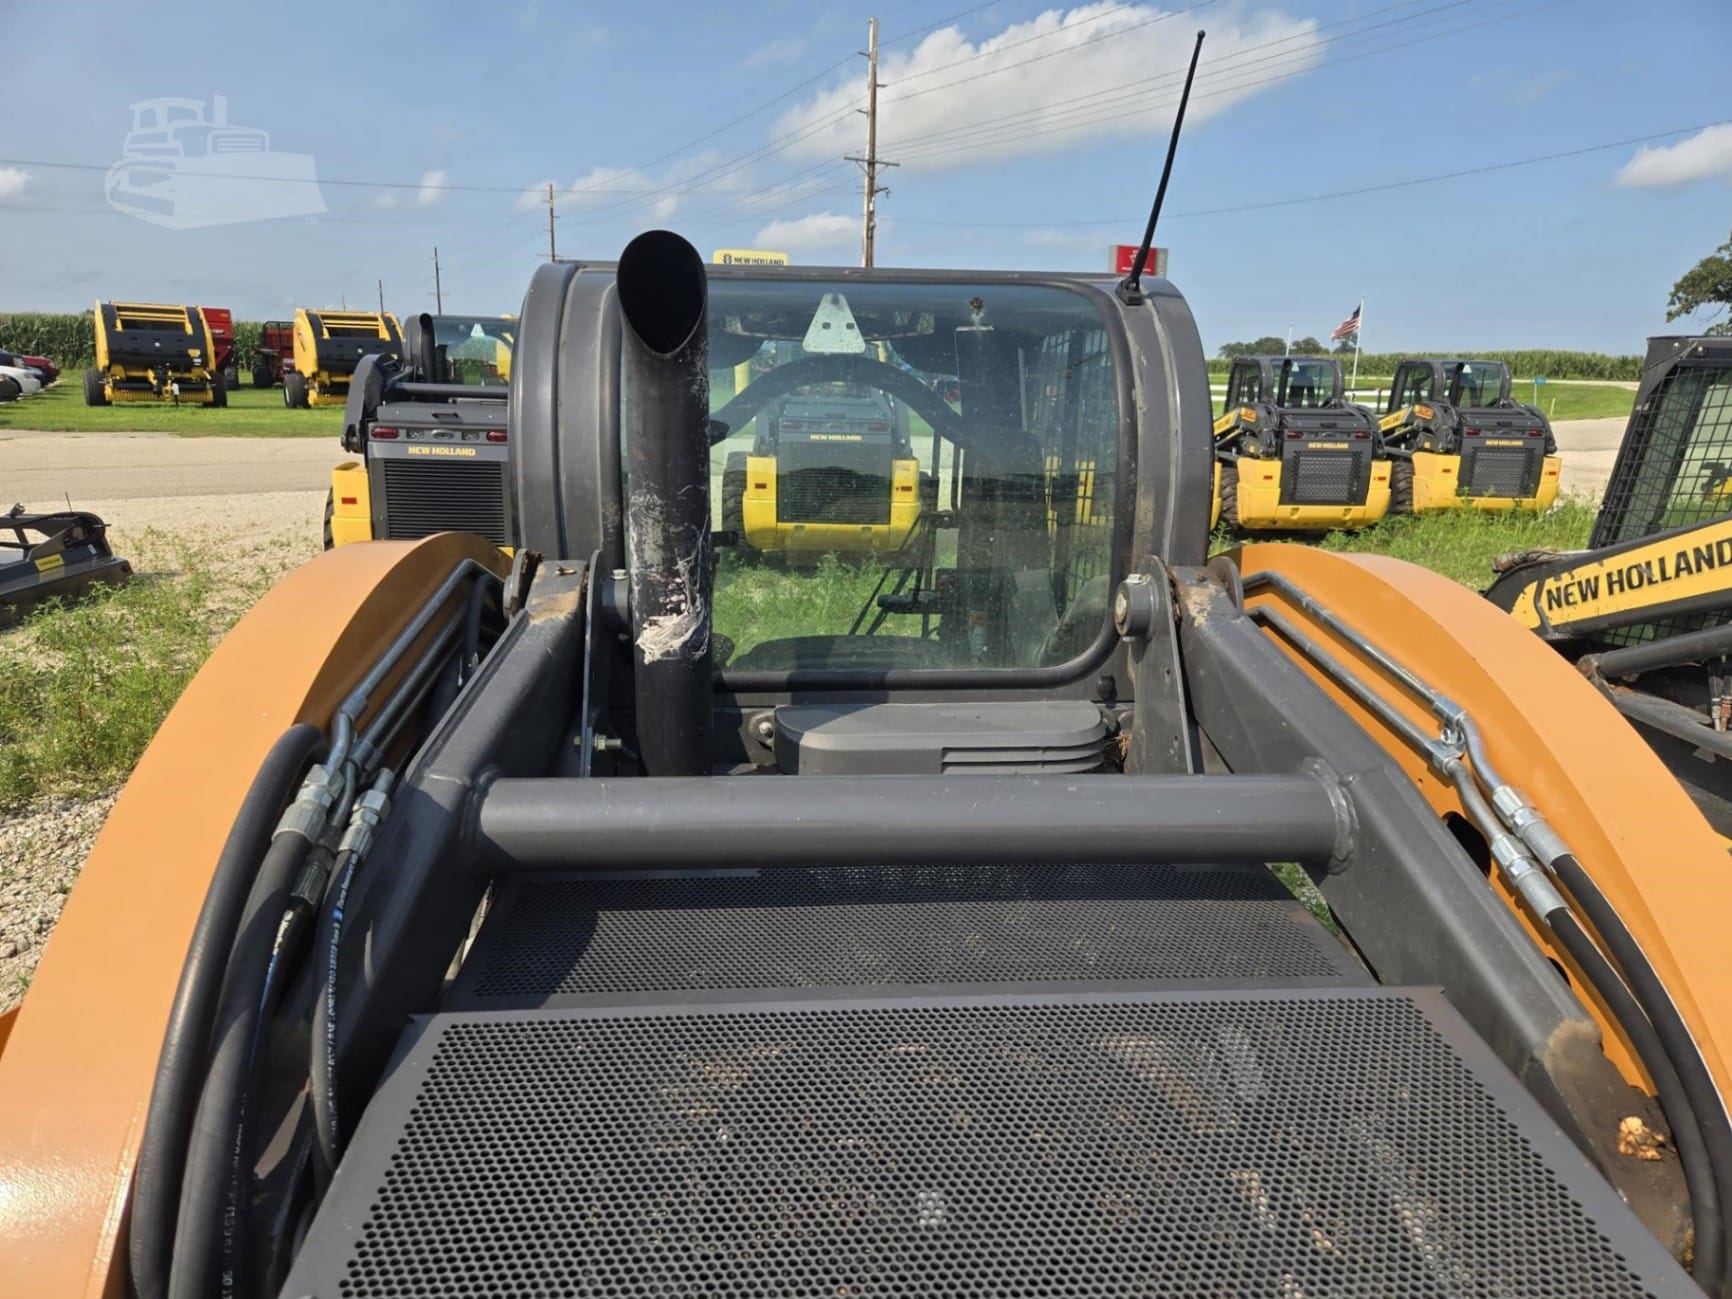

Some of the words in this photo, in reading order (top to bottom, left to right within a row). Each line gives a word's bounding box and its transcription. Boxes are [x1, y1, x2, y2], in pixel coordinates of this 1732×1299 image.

[734, 256, 750, 265] NEW
[827, 434, 862, 442] HOLLAND
[408, 446, 431, 455] NEW
[431, 447, 477, 457] HOLLAND
[1546, 575, 1600, 611] NEW
[1606, 537, 1732, 596] HOLLAND
